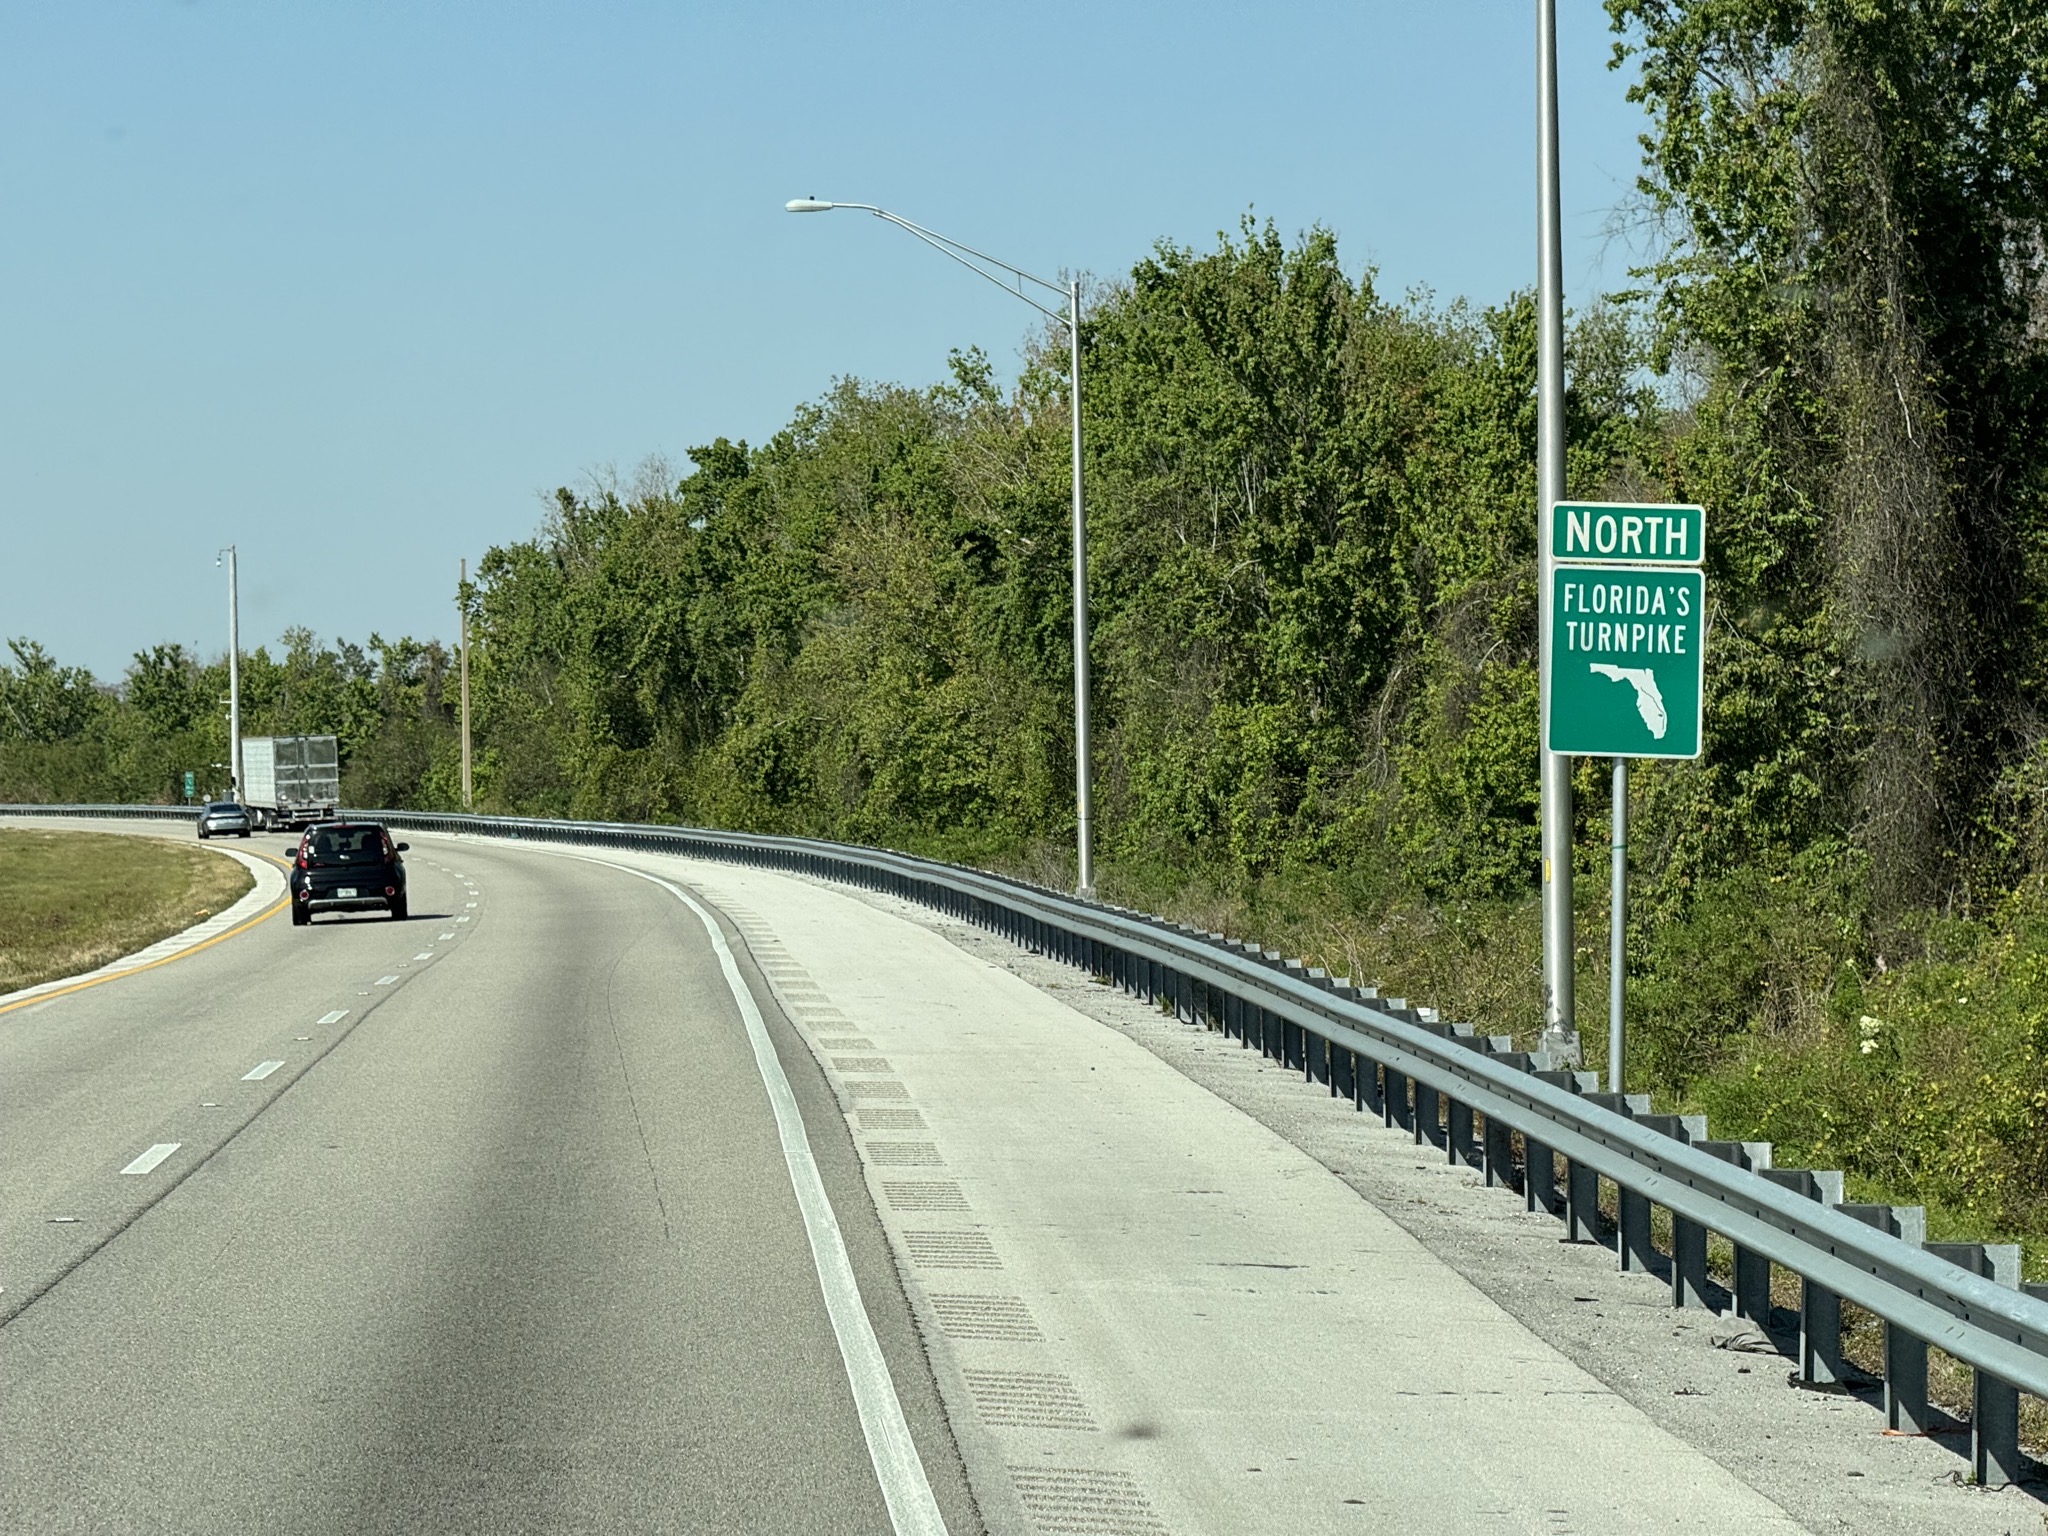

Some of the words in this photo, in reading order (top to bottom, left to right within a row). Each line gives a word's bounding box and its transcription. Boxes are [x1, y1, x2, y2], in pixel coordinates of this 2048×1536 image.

[1567, 511, 1687, 554] NORTH
[1564, 583, 1690, 616] FLORIDA'S
[1567, 621, 1686, 654] TURNPIKE
